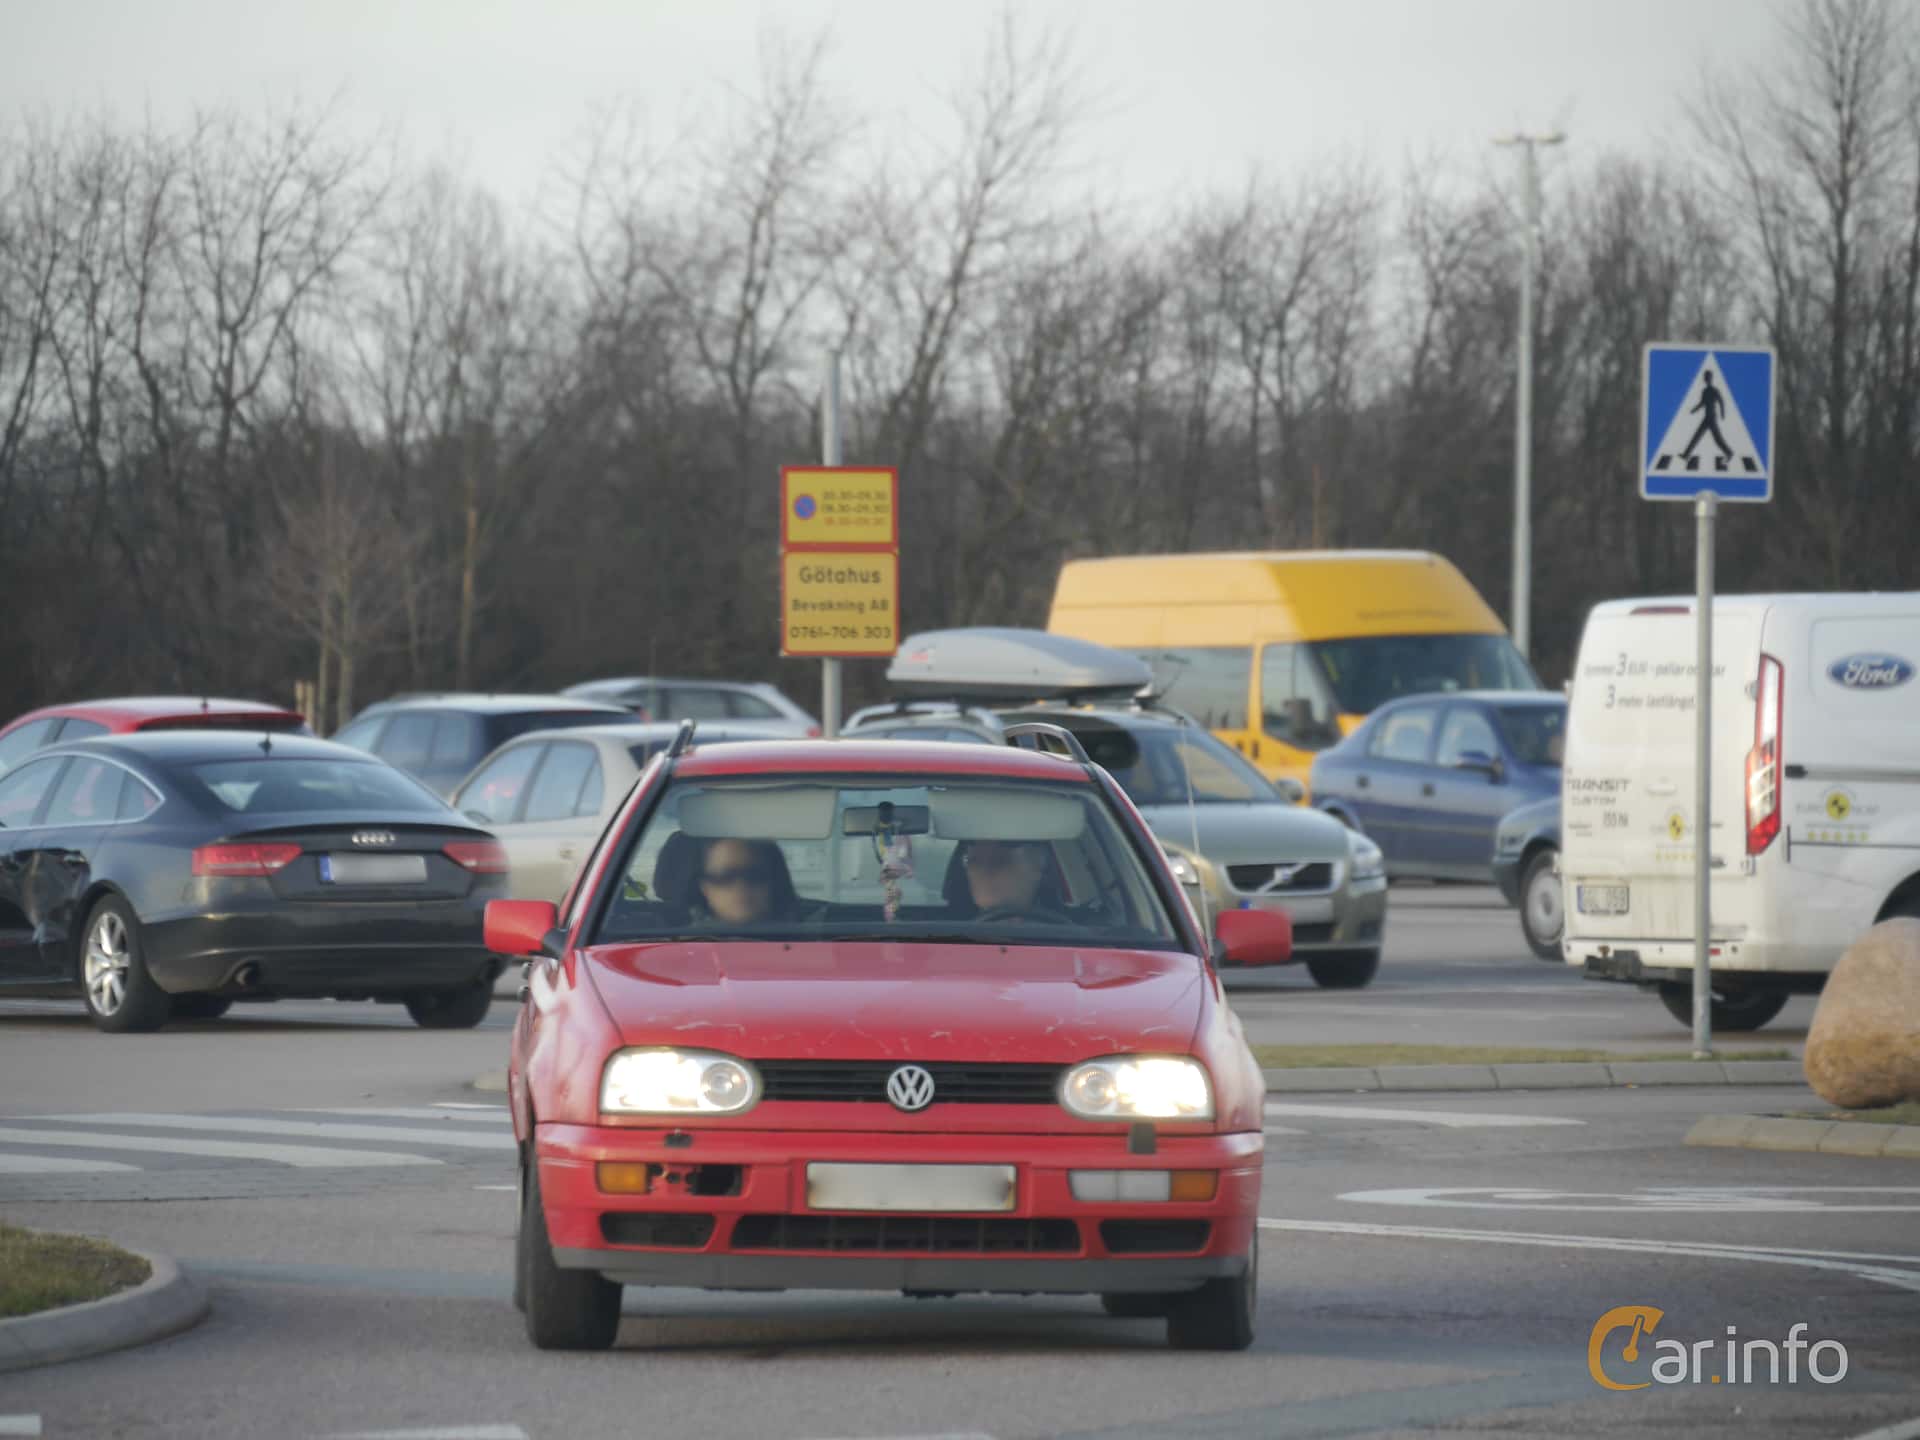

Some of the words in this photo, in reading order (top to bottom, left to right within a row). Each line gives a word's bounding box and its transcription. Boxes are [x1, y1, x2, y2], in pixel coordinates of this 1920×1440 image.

[798, 565, 881, 584] Götahus
[792, 599, 865, 614] Bevakning
[870, 599, 889, 611] AB
[790, 625, 859, 639] 0761-706
[863, 625, 891, 639] 303
[1616, 652, 1628, 677] 3
[1843, 656, 1900, 685] Ford
[1605, 684, 1616, 709] 3
[1566, 778, 1632, 792] TRANSIT
